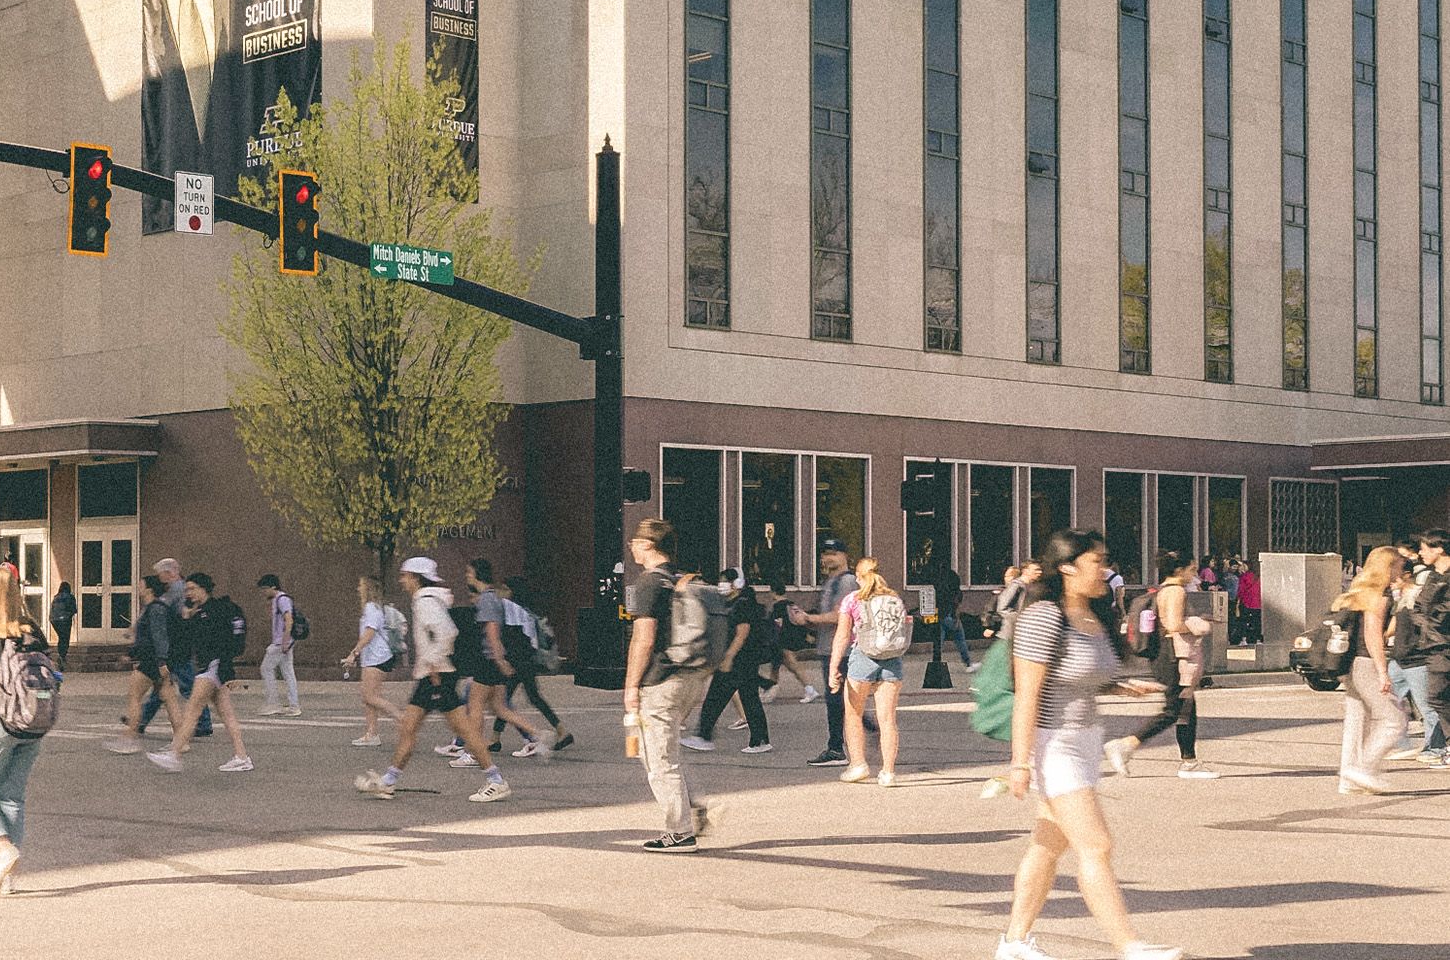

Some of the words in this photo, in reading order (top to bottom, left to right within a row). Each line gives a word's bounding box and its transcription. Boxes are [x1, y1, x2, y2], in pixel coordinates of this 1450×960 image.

[464, 0, 475, 15] OF
[433, 15, 474, 36] BUSINESS
[245, 25, 303, 58] BUSINESS
[186, 177, 202, 190] NO
[183, 191, 206, 203] TURN
[178, 203, 191, 213] ON
[193, 205, 210, 216] RED
[373, 243, 394, 262] Mitch
[395, 246, 421, 266] Daniels
[422, 250, 439, 268] Blvd
[397, 263, 418, 281] State
[420, 265, 430, 282] St
